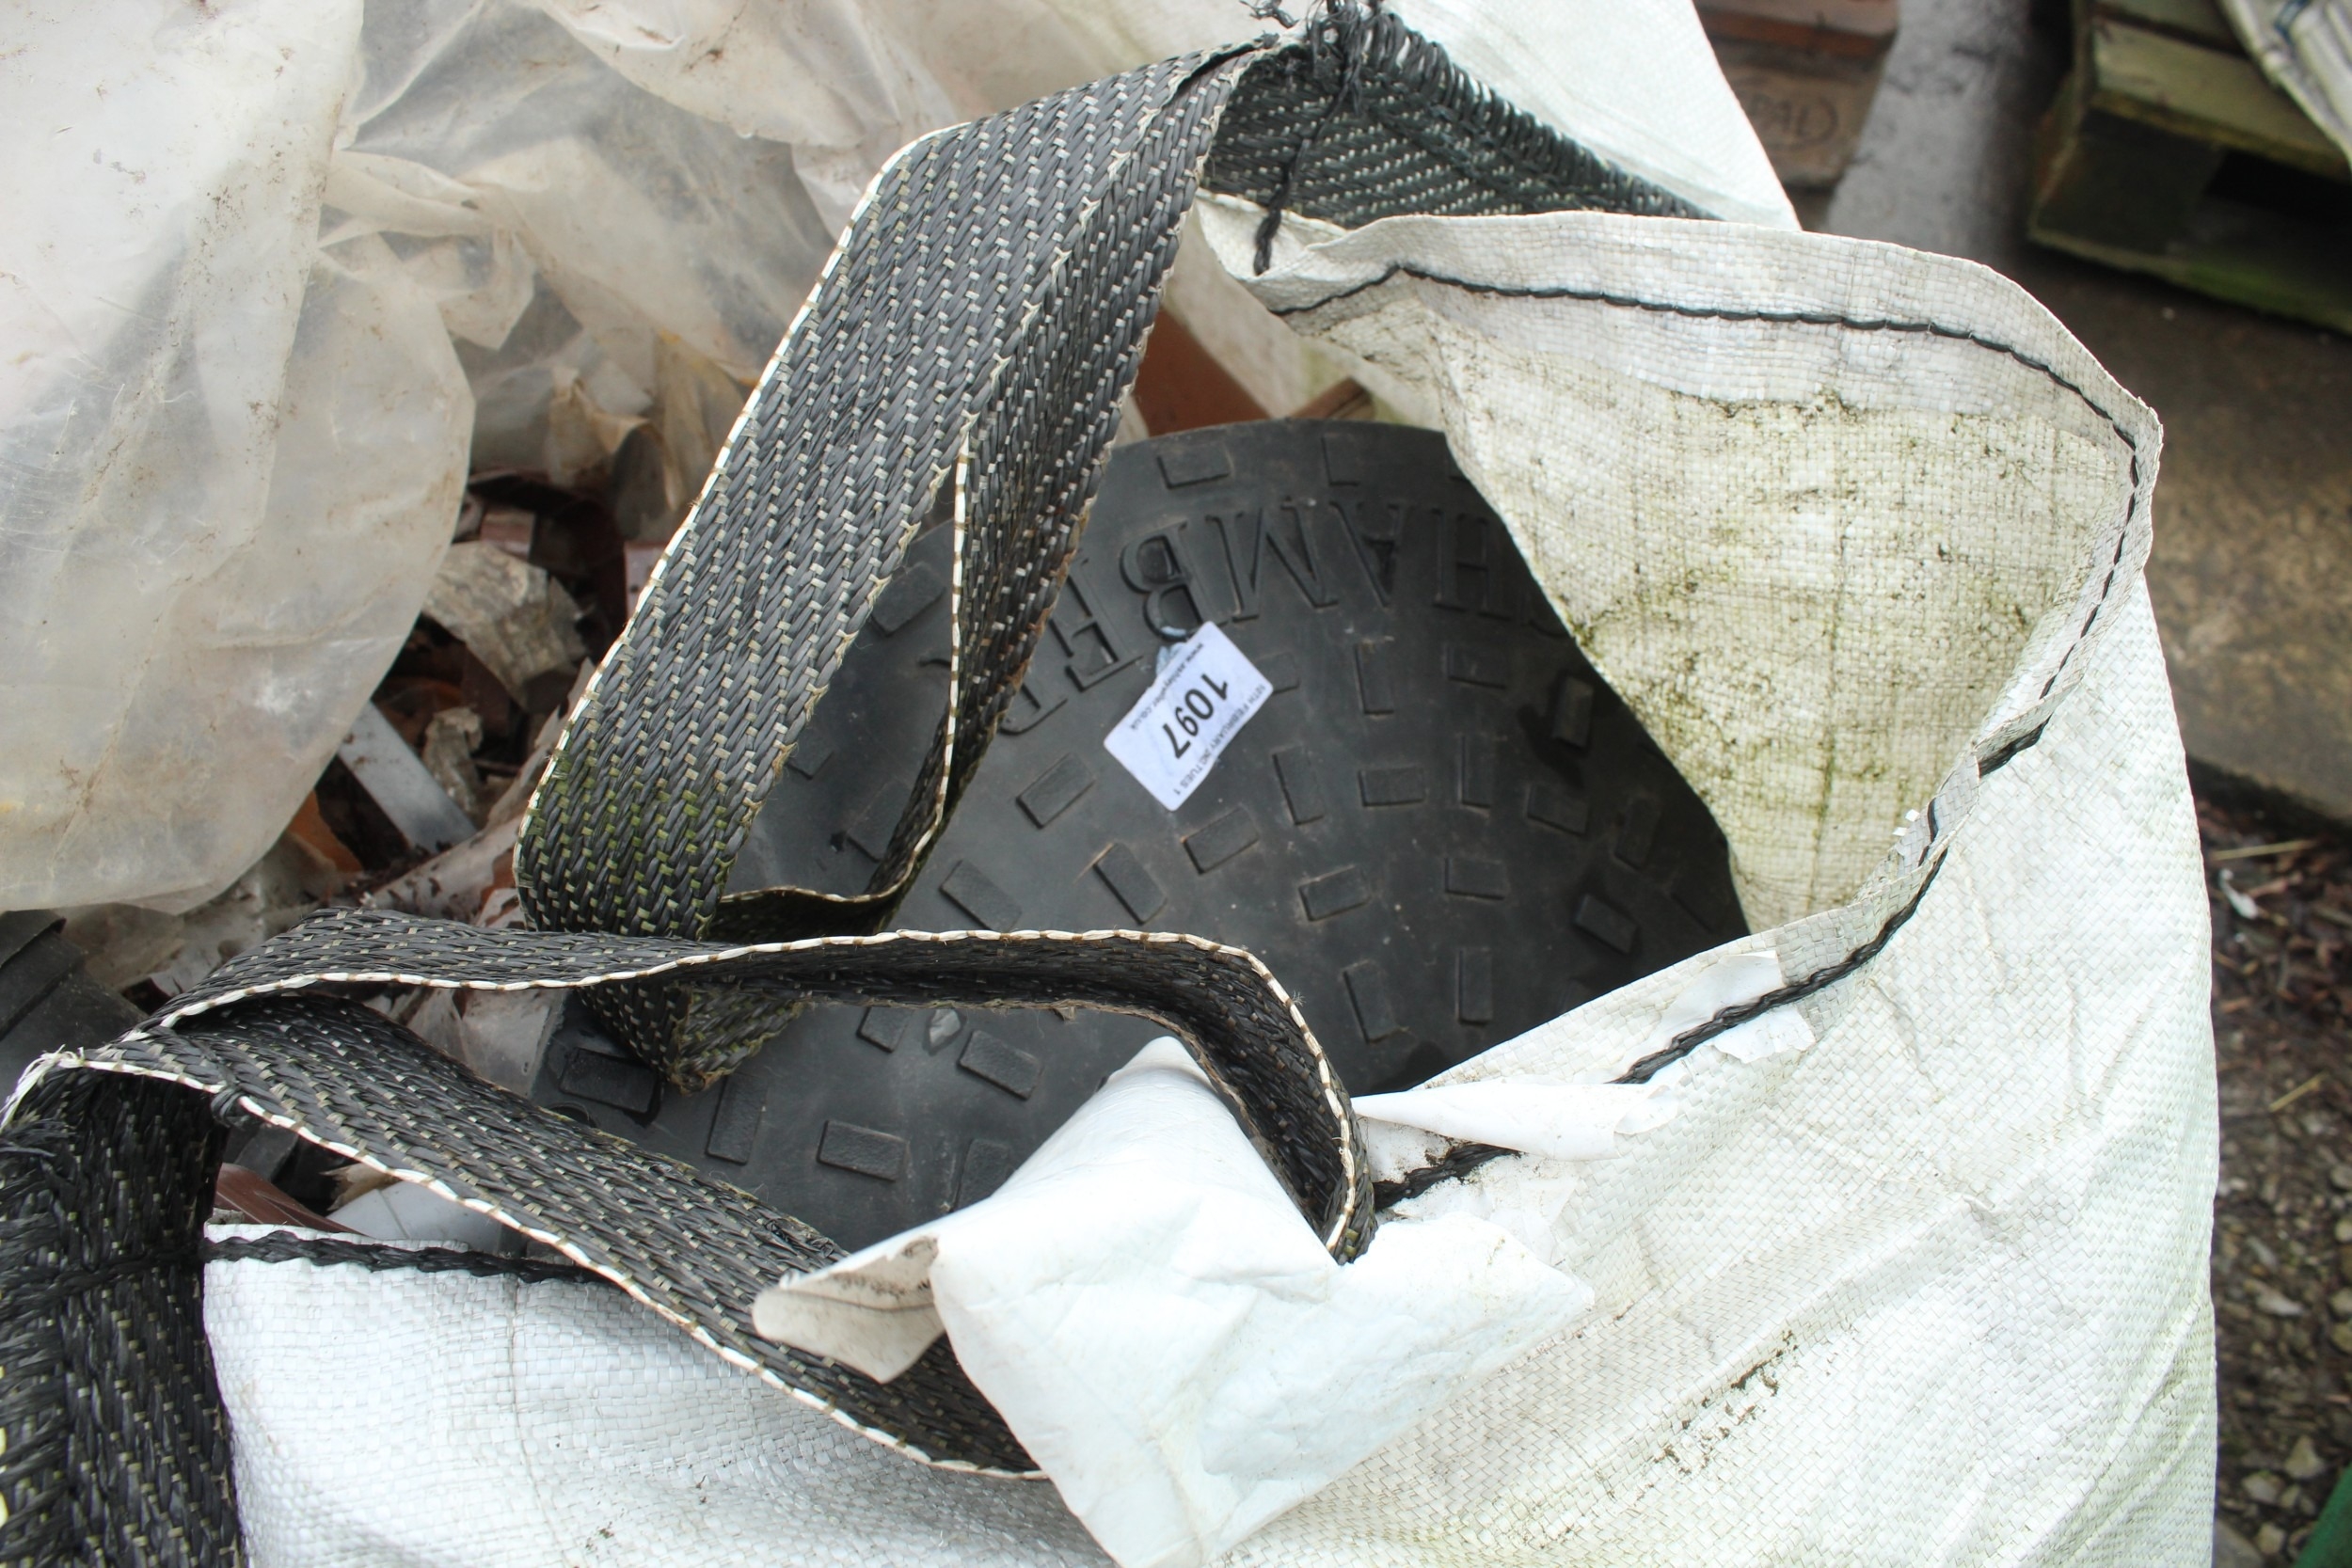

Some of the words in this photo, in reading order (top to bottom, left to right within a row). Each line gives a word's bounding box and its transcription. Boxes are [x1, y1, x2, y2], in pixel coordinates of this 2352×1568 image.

[1162, 673, 1229, 759] 1097
[1211, 703, 1249, 750] FEBRUARY
[1180, 763, 1203, 788] TUES
